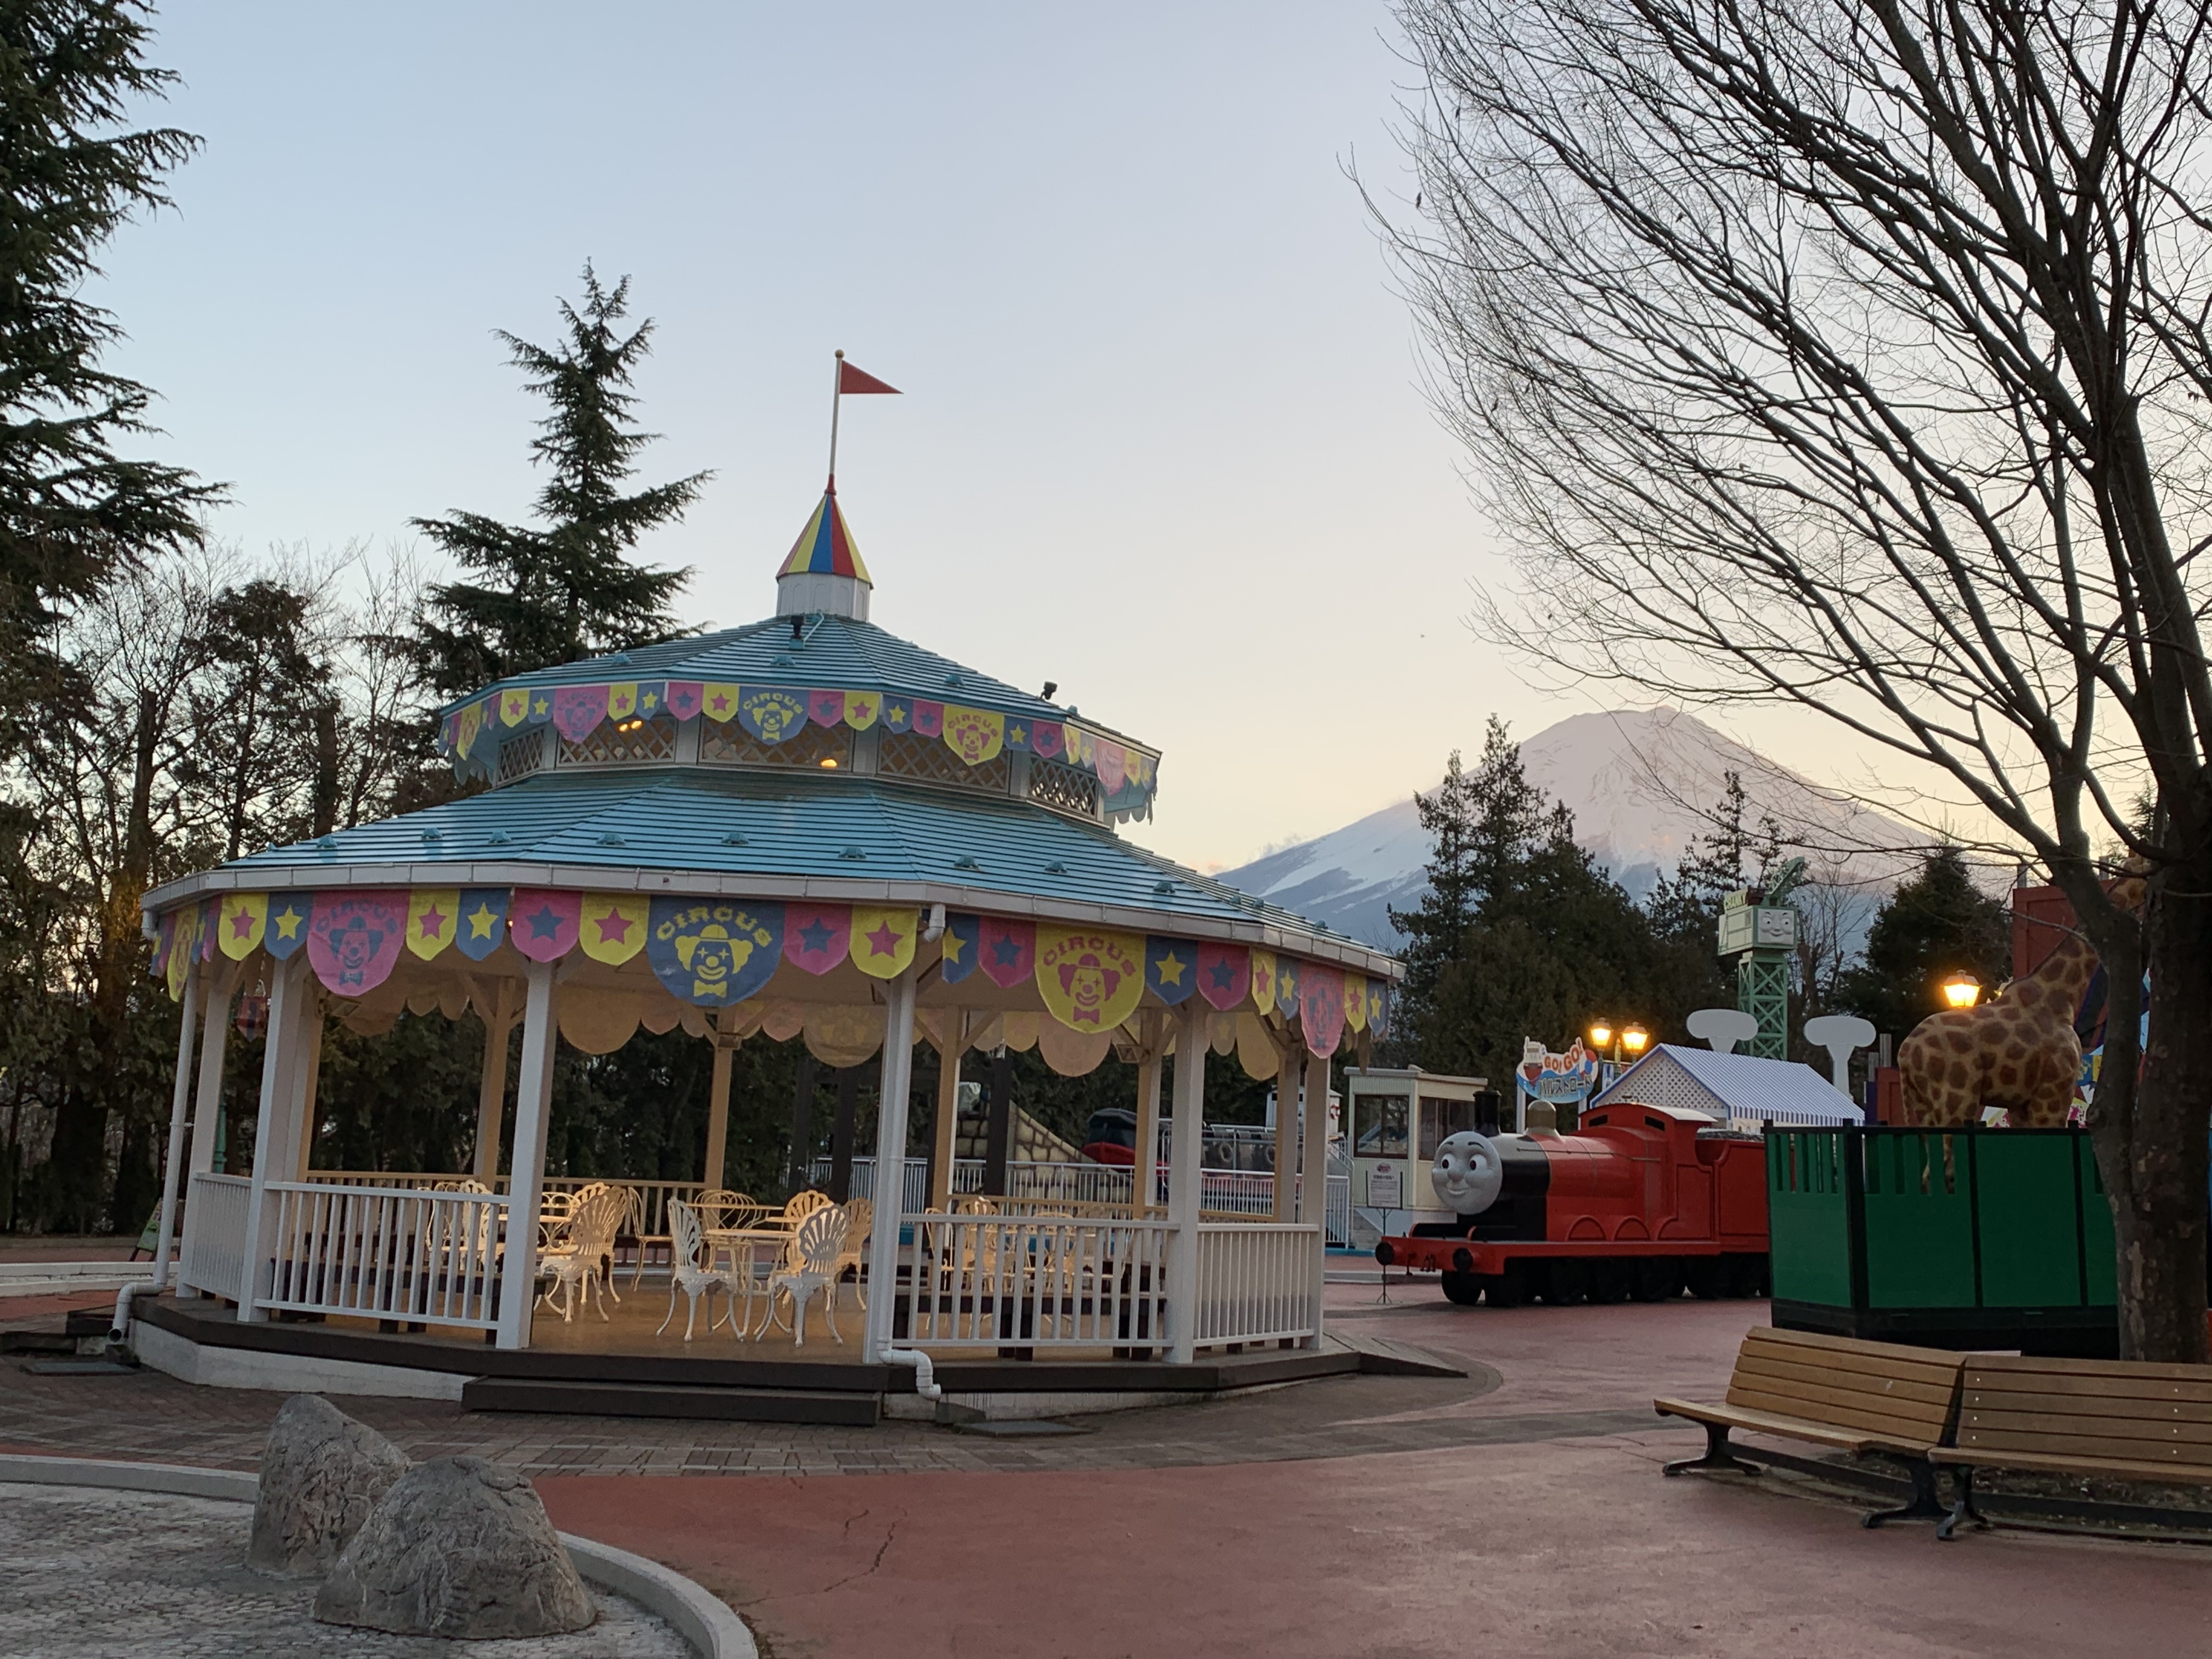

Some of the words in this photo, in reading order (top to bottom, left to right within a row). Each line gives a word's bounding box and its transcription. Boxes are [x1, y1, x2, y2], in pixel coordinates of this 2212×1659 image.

[743, 692, 803, 714] CIRCUS
[947, 714, 998, 737] CIRCUS
[315, 899, 398, 935] CIRCUS
[657, 906, 772, 948] CIRCUS
[1043, 936, 1136, 977] CIRCUS
[1544, 1055, 1562, 1074] GO!
[1564, 1039, 1582, 1071] GO!
